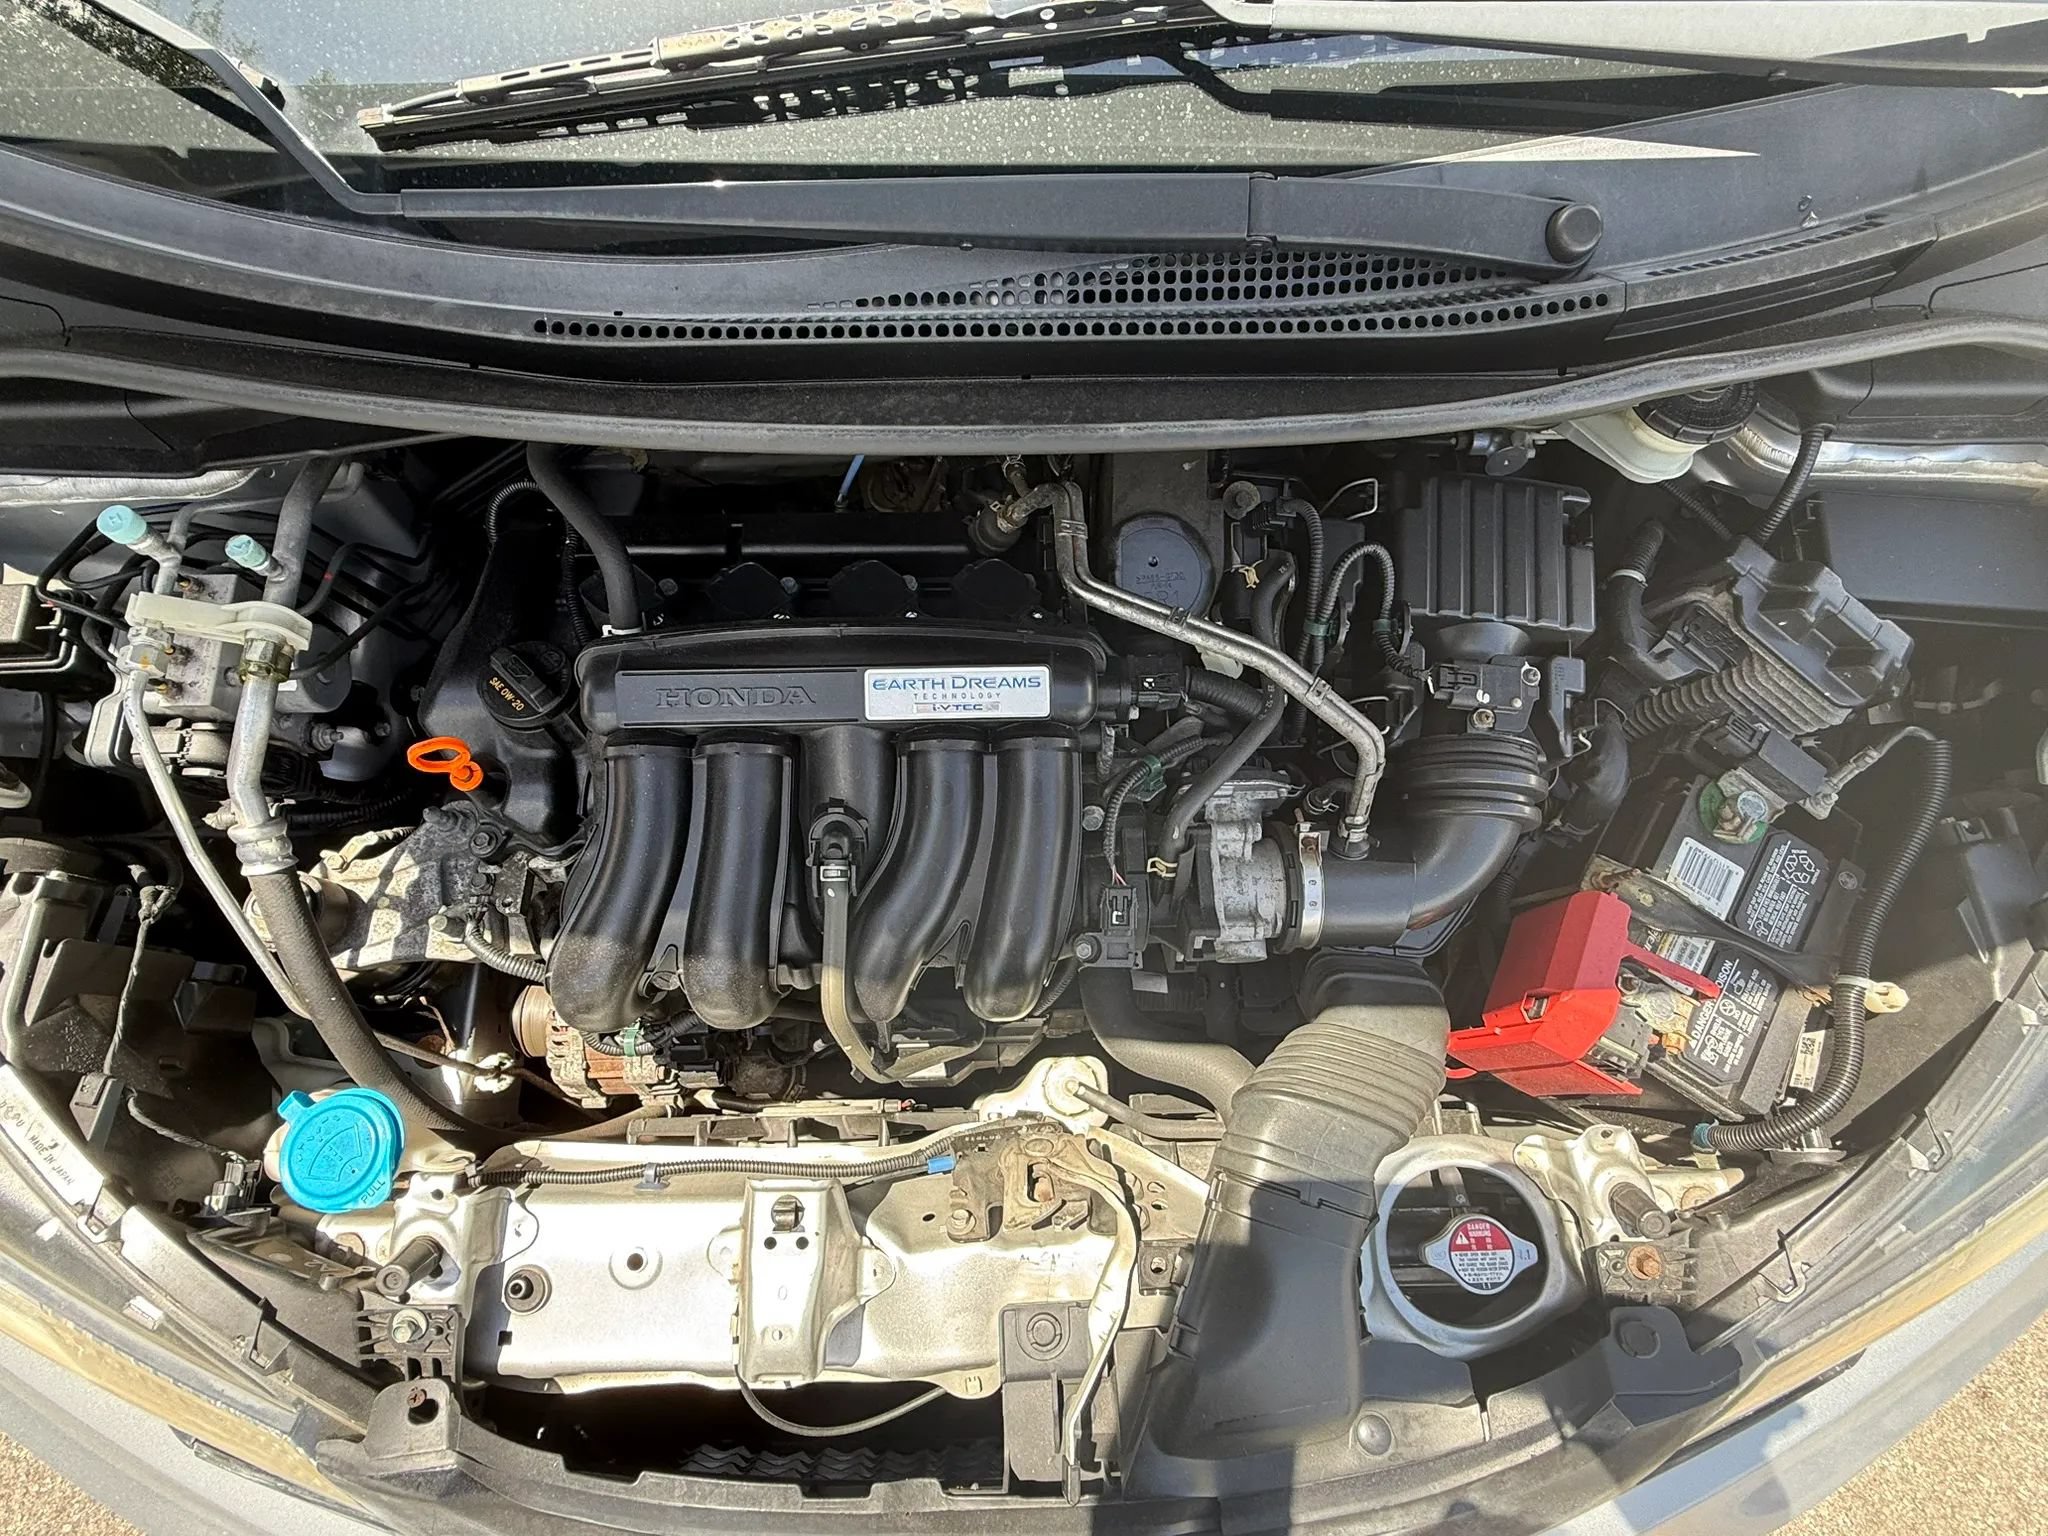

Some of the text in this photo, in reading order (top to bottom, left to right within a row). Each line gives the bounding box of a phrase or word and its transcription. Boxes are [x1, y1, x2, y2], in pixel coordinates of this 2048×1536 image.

[488, 675, 504, 691] SAE
[873, 676, 1041, 690] EARTH DREAMS
[656, 686, 816, 708] HONDA
[914, 692, 1001, 700] TECHNOLOGY
[28, 1133, 75, 1187] MADE IN JAPAN
[360, 1176, 385, 1204] PULL
